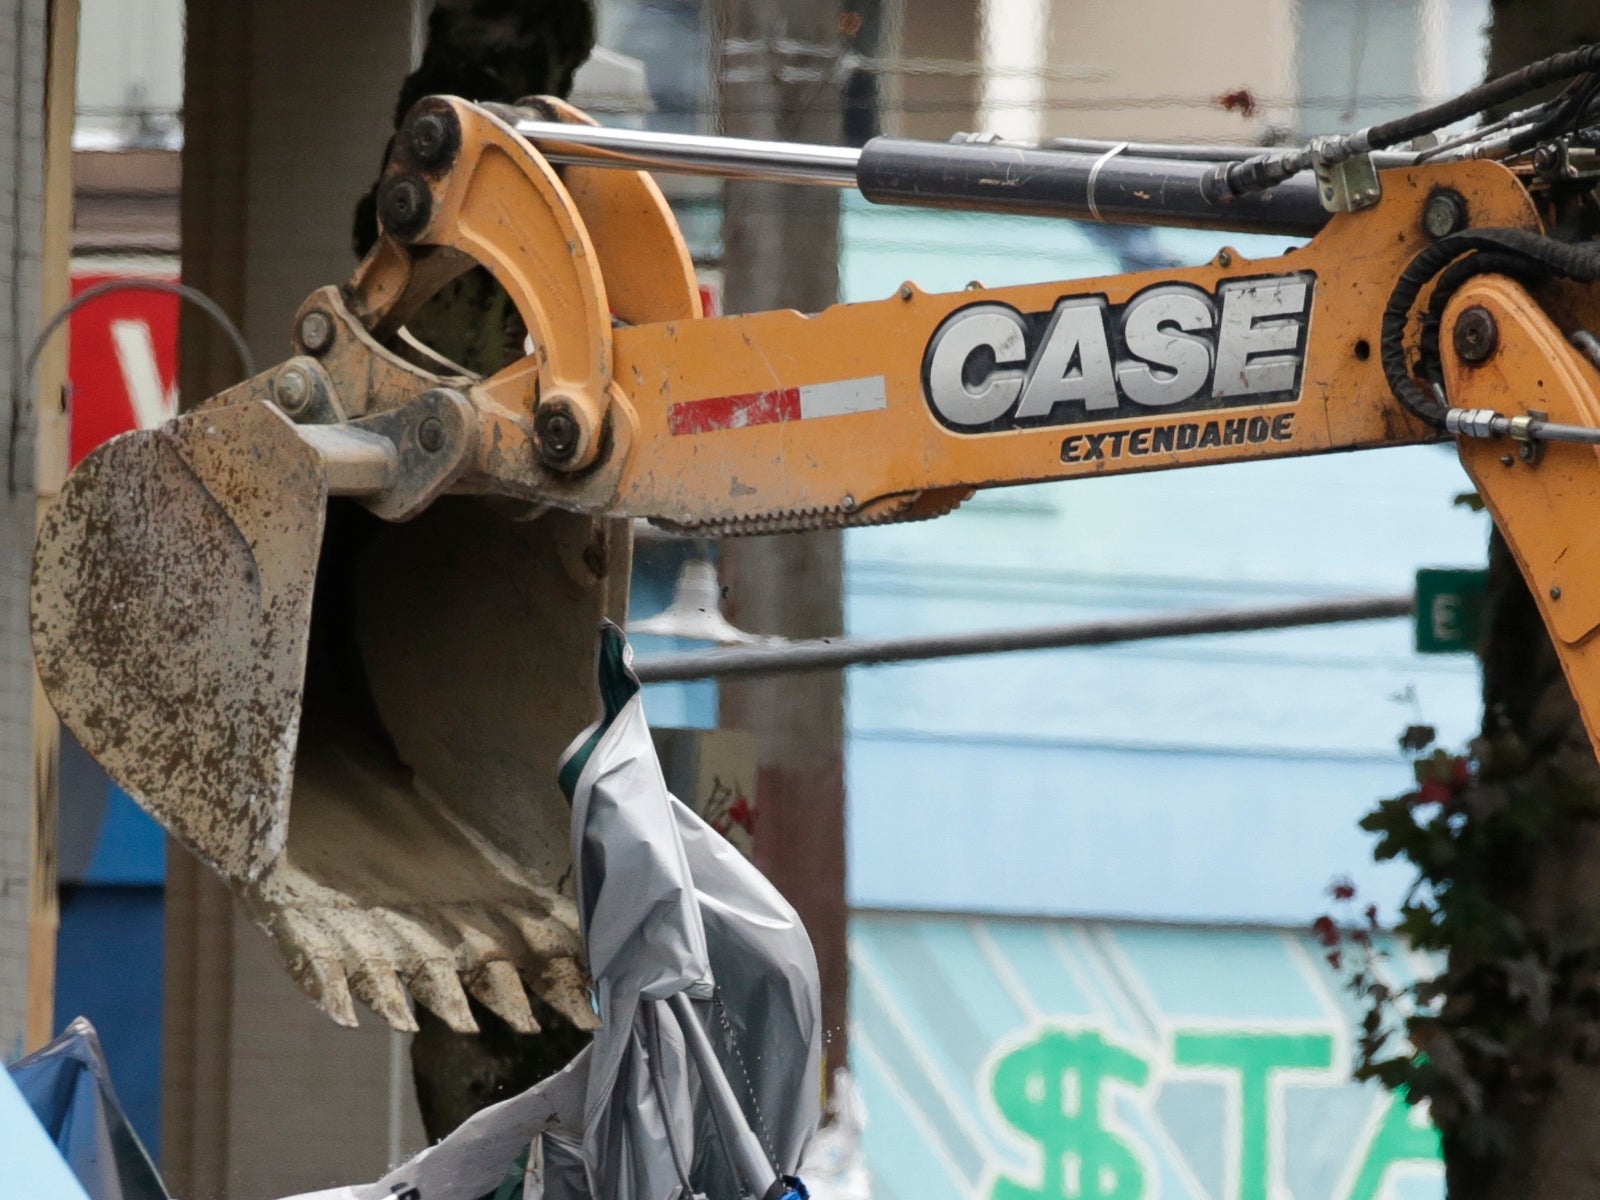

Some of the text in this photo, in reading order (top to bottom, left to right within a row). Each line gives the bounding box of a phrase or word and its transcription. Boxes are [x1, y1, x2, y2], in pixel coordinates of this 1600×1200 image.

[922, 278, 1310, 428] CASE
[1060, 413, 1295, 463] EXTENDAHOE
[1432, 593, 1462, 641] E
